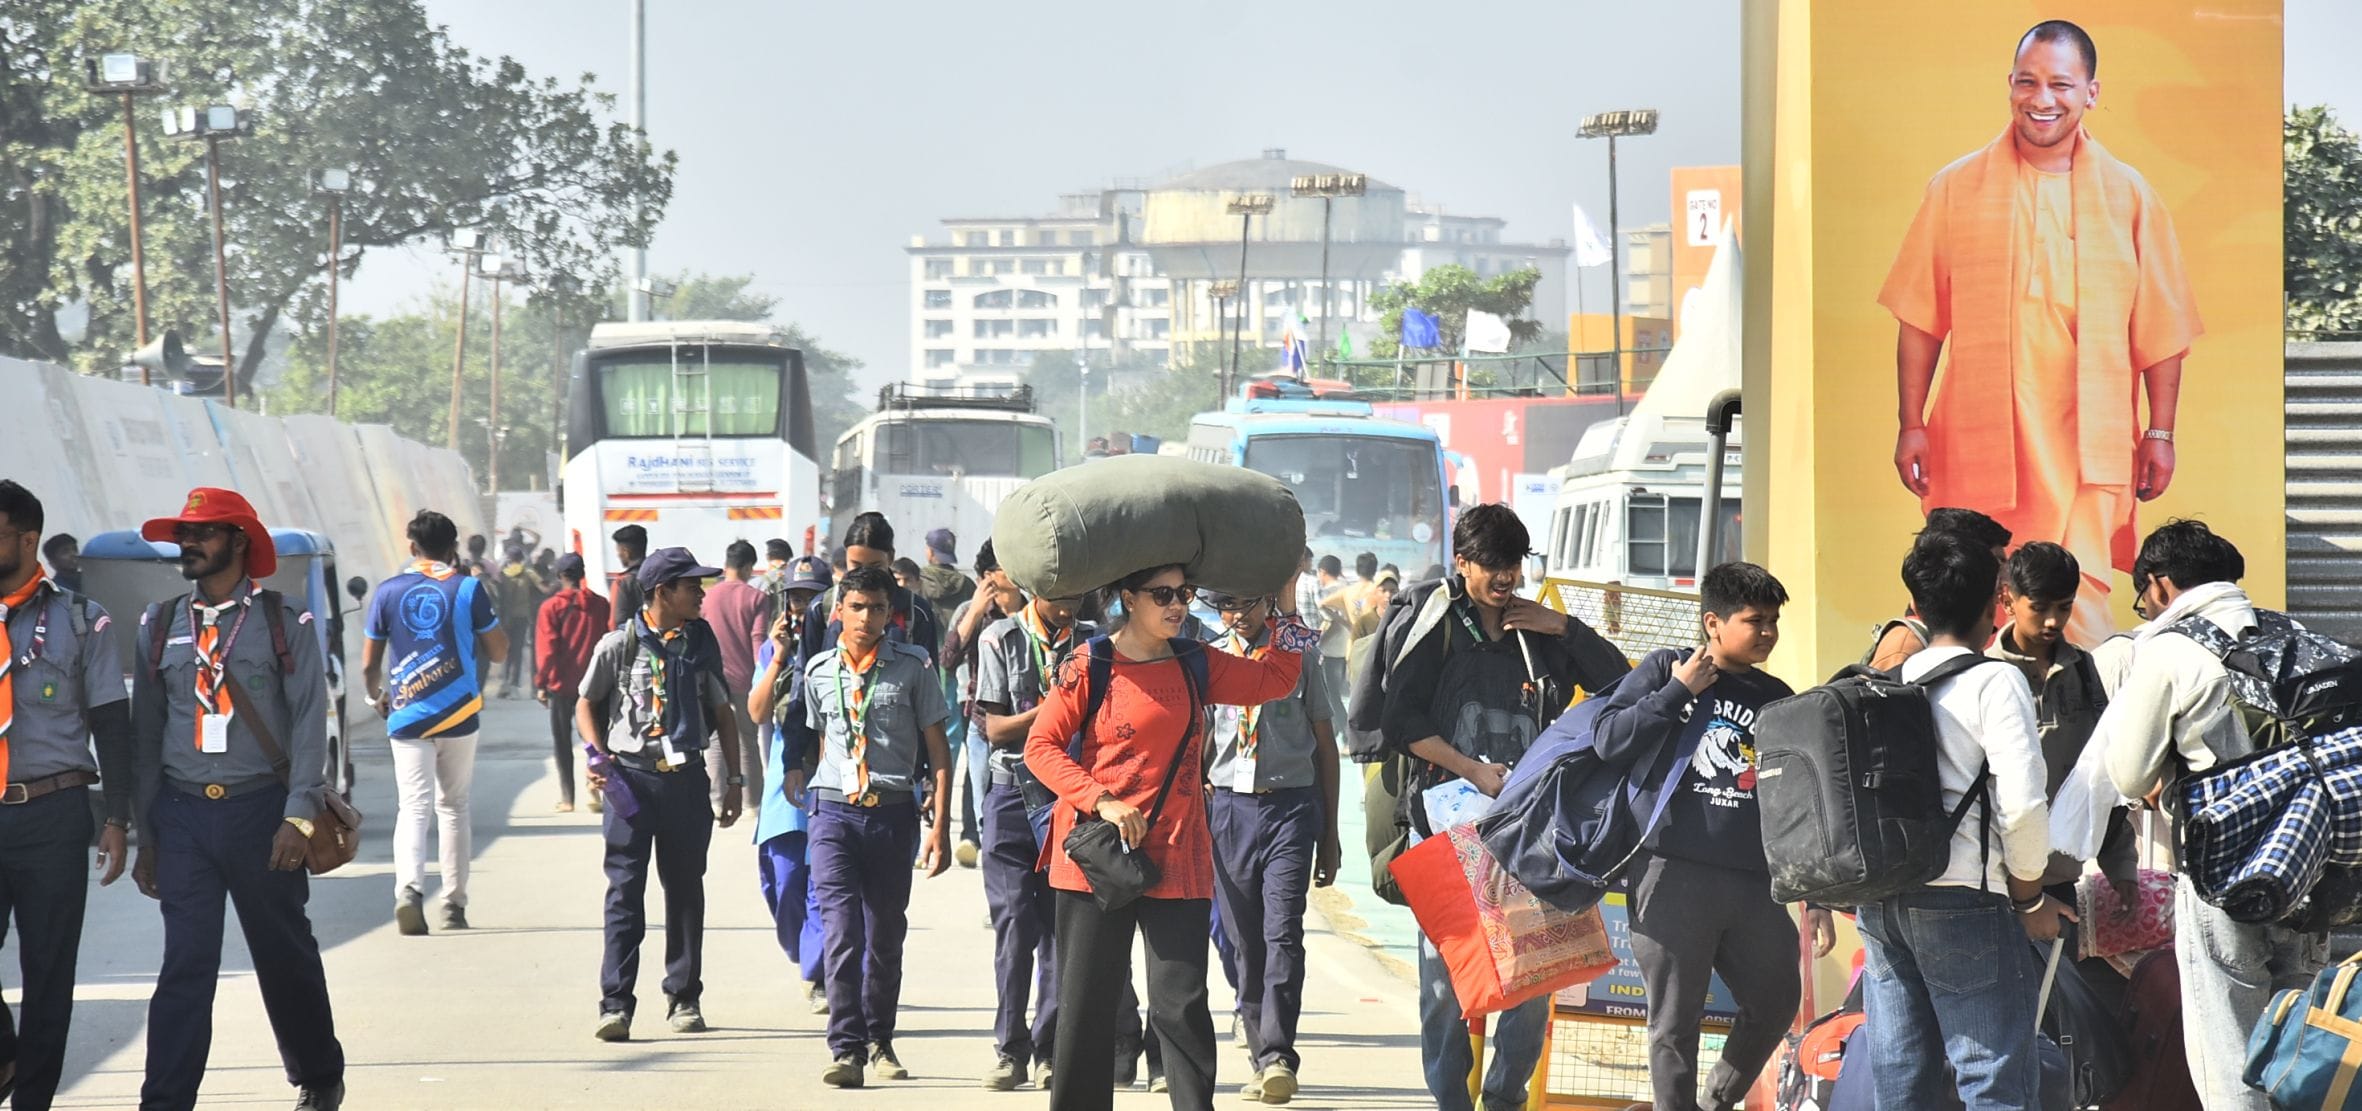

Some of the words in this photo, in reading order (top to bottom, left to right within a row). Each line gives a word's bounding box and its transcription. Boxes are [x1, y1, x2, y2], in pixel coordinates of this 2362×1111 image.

[1700, 213, 1708, 240] 2
[392, 657, 456, 710] Jamboree
[1710, 797, 1739, 809] JUXAR
[1609, 984, 1645, 997] IND
[1606, 1005, 1646, 1018] FROM
